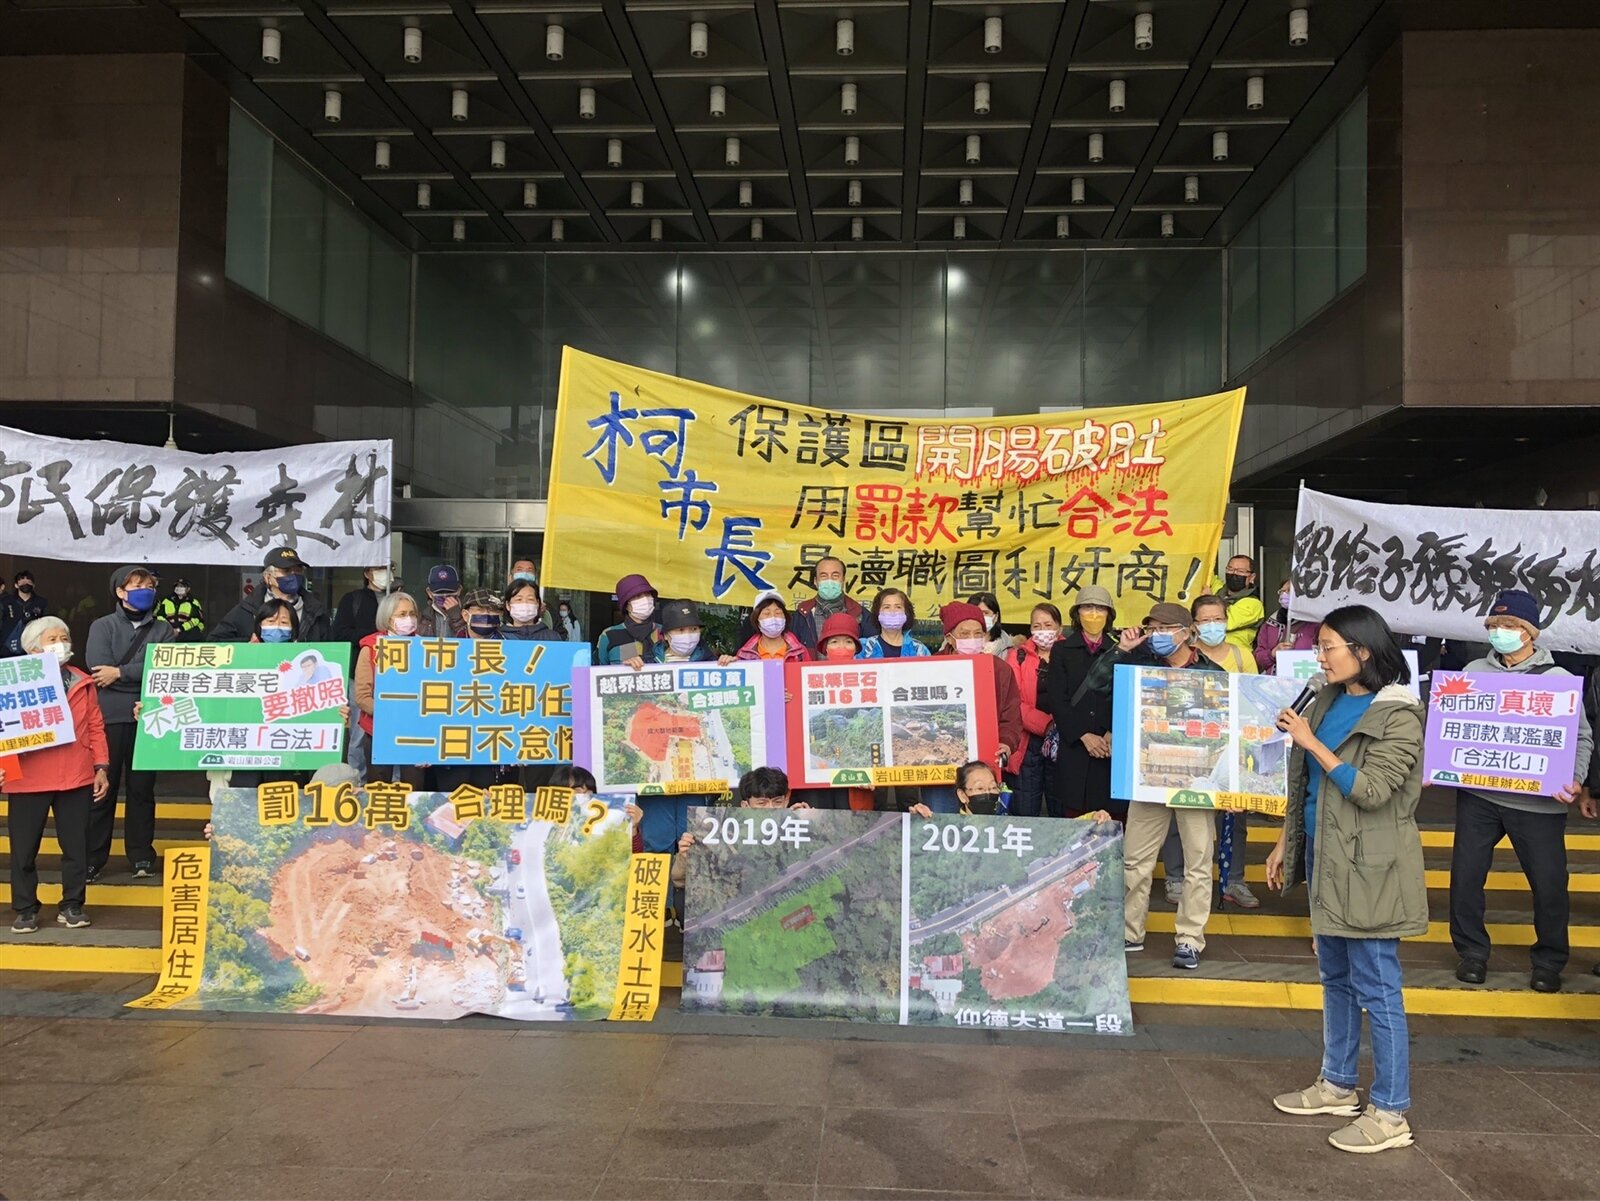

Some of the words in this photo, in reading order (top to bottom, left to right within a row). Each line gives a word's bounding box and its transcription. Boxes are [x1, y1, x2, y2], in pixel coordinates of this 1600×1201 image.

[789, 484, 1174, 545] 用罰款幫忙合法
[153, 646, 232, 667] 柯市長！
[375, 637, 545, 676] 柯市長！
[149, 671, 279, 694] 假農舍真豪宅
[892, 686, 963, 702] 合理嗎？
[263, 678, 346, 721] 要撤照
[379, 680, 573, 718] 一日未卸任
[1440, 694, 1495, 712] 柯市府
[1500, 690, 1575, 716] 真壞！
[143, 698, 200, 736] 不是
[183, 726, 338, 749] 罰款幫「合法」！
[1454, 748, 1544, 772] 「合法化」！
[1461, 773, 1540, 792] 岩山里辦公處
[261, 783, 410, 828] 罰16萬
[450, 785, 606, 834] 合理嗎？
[702, 815, 811, 848] 2019年
[922, 823, 1034, 858] 2021年
[954, 1008, 1123, 1033] 仰德大道一段
